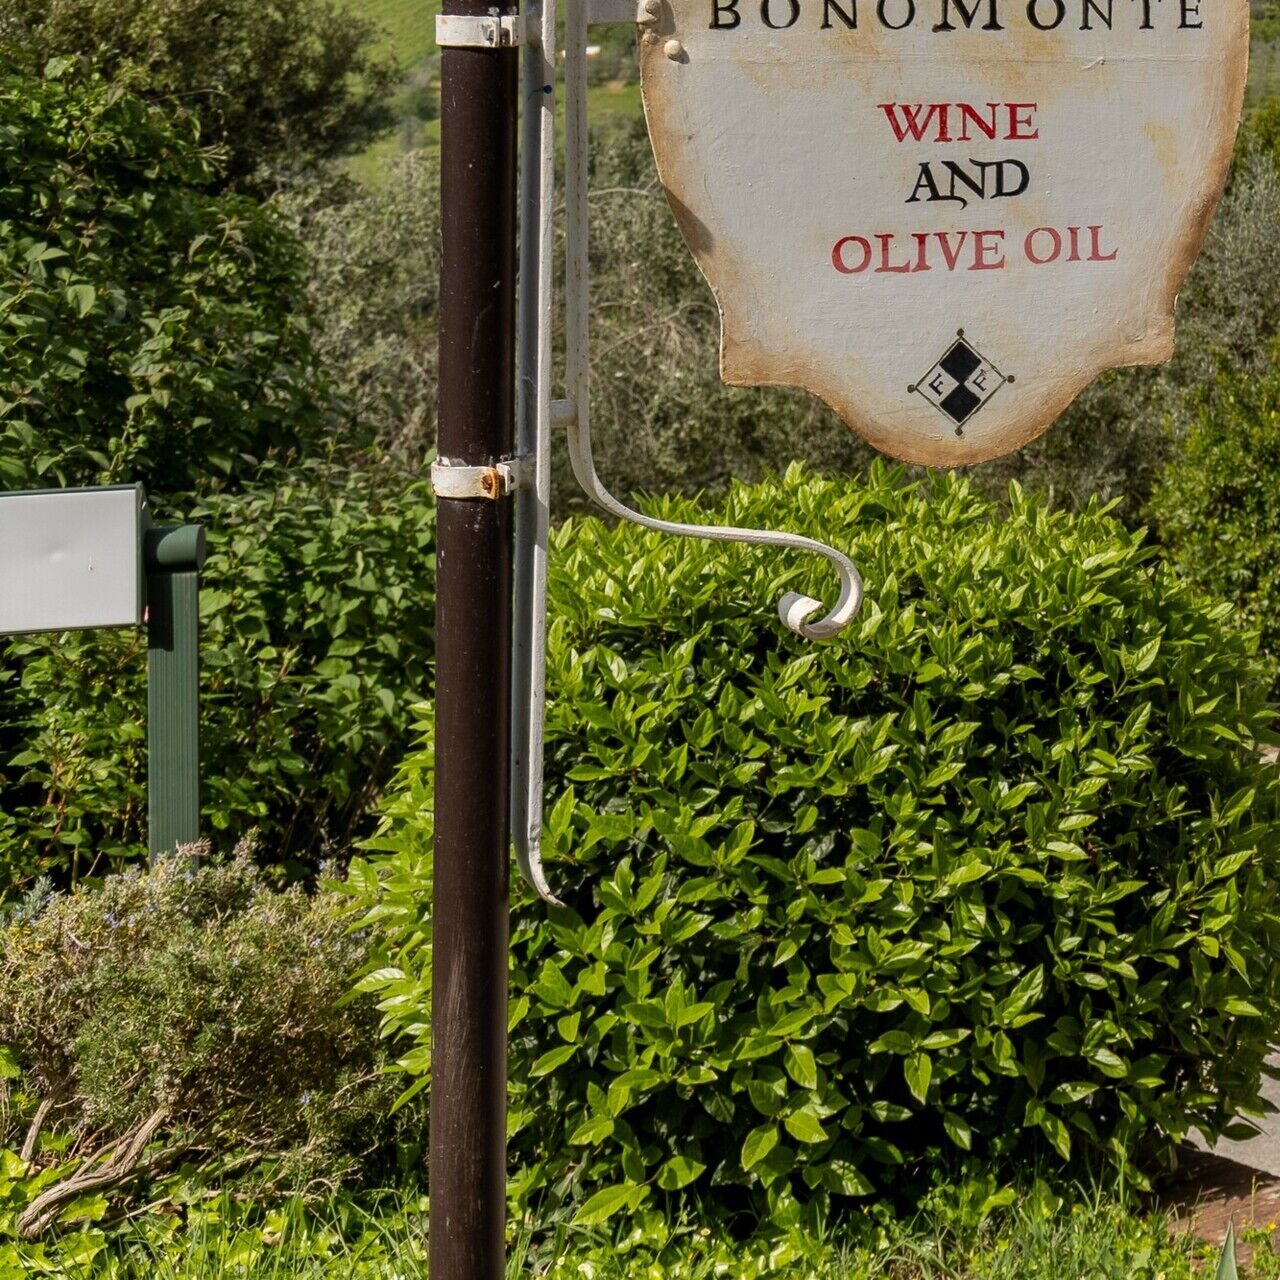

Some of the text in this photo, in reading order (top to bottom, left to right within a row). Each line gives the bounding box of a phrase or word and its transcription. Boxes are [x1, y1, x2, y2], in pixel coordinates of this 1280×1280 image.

[877, 102, 1040, 143] WINE
[904, 158, 1030, 209] AND
[831, 225, 1118, 275] OLIVE OIL
